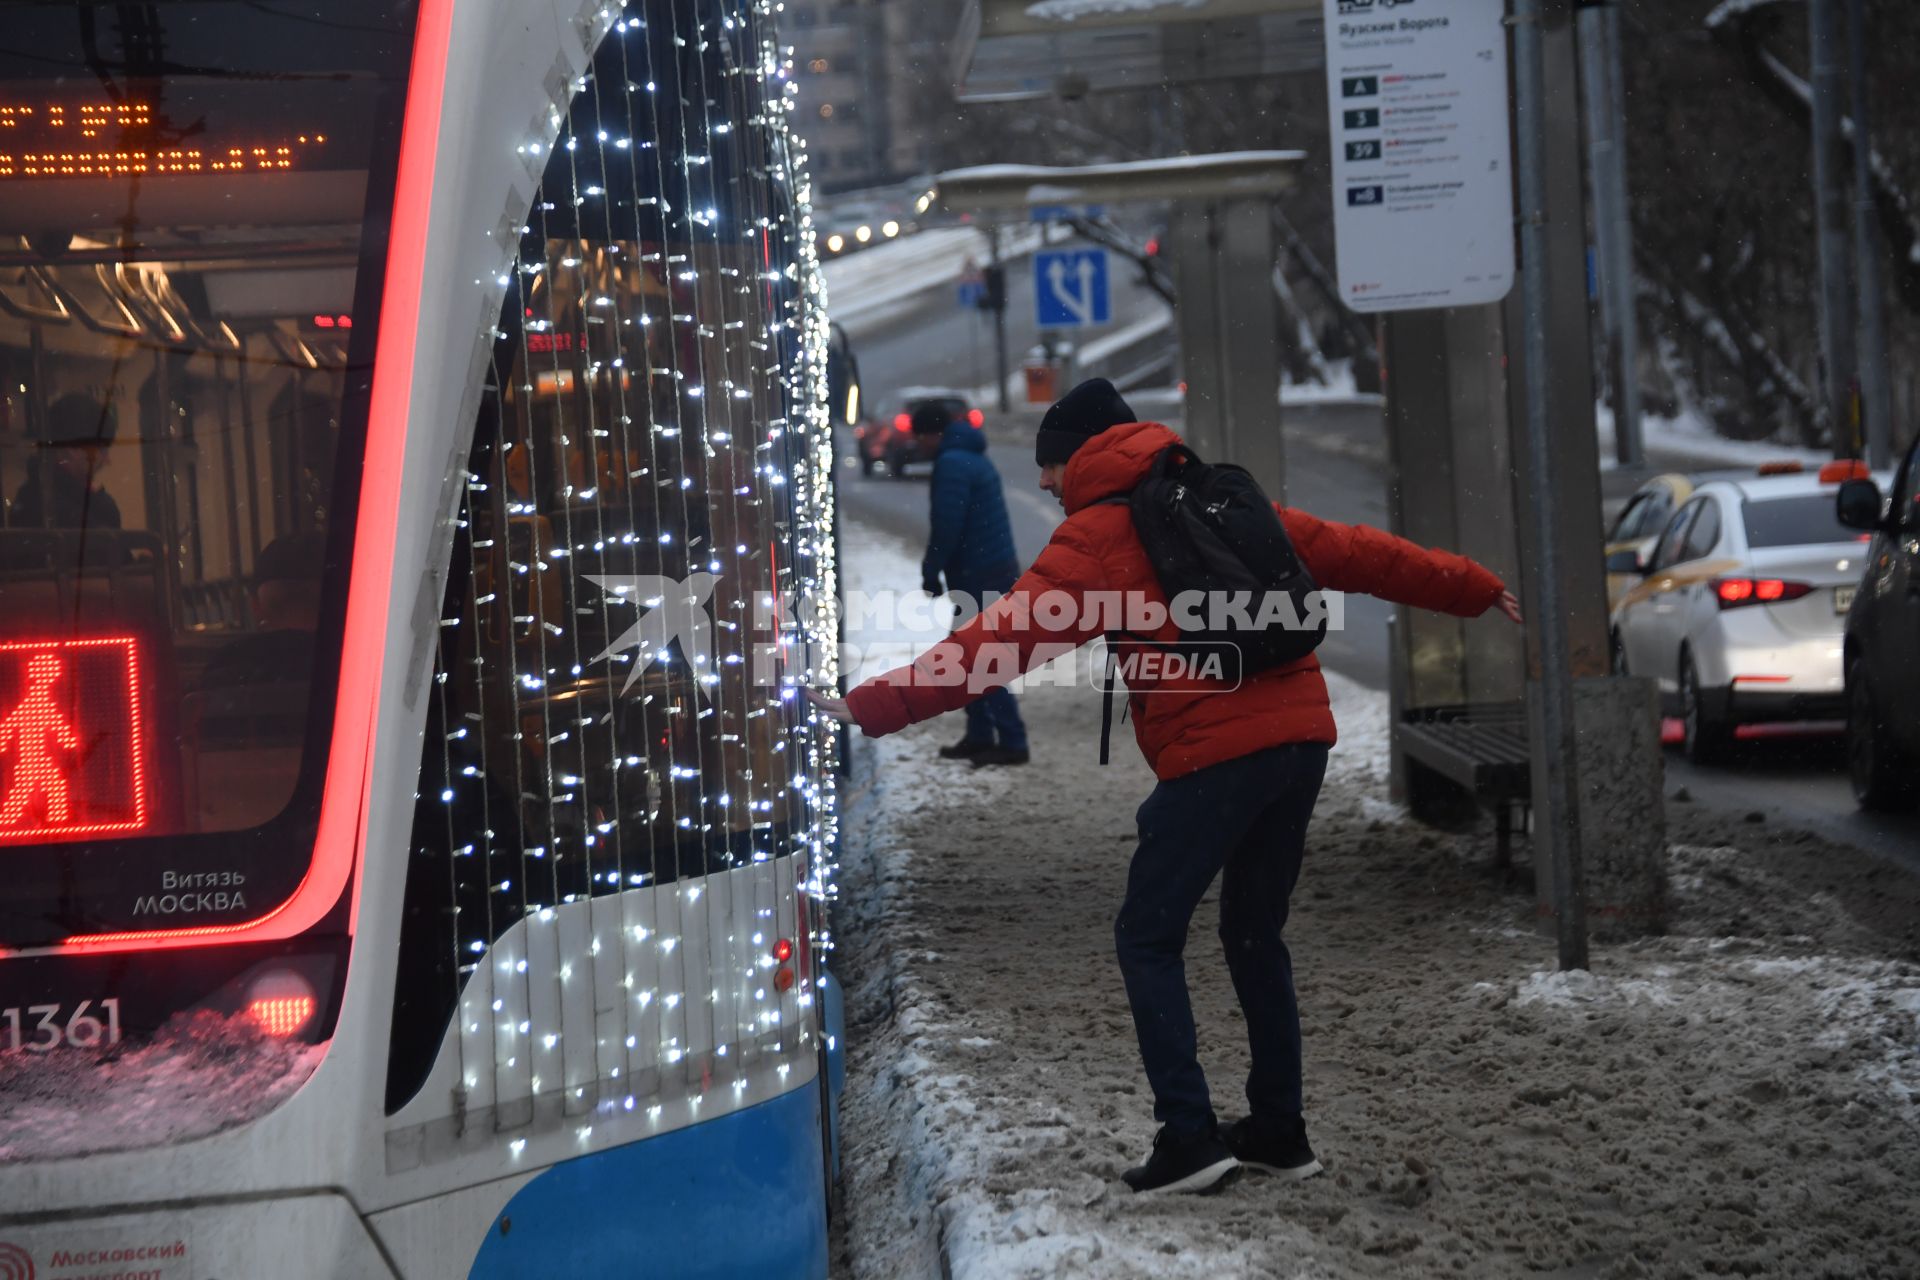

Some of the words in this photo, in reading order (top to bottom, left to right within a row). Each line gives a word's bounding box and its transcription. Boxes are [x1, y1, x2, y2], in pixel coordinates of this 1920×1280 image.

[1399, 17, 1450, 31] Ворота
[162, 870, 246, 890] Витязь
[132, 891, 247, 916] МОСКВА
[2, 997, 121, 1051] 1361
[50, 1240, 186, 1268] Московский
